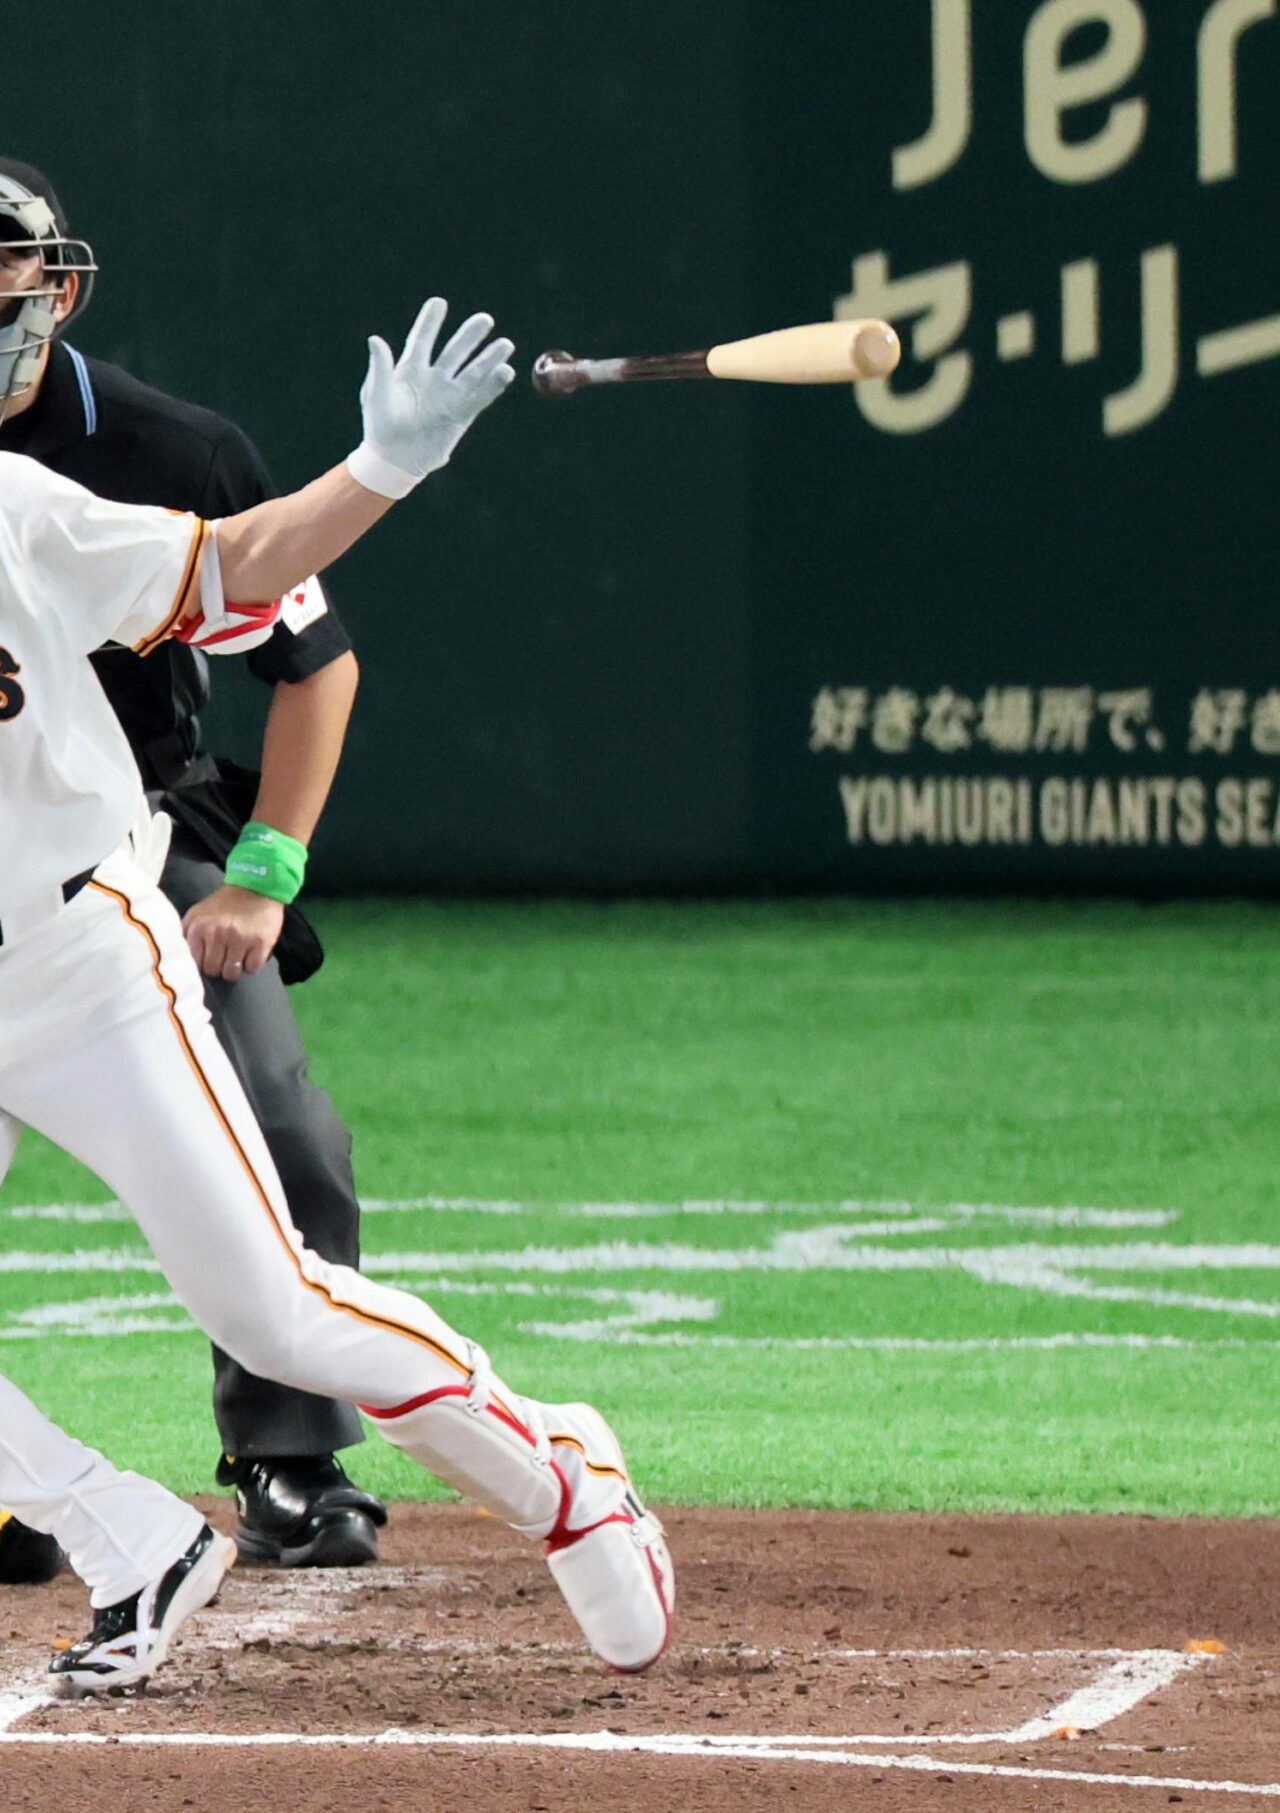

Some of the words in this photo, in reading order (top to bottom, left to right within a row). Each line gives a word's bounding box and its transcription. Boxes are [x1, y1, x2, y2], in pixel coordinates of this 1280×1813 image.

[839, 775, 1032, 846] YOMIURI
[1039, 775, 1206, 847] GIANTS
[1215, 776, 1280, 847] SE
